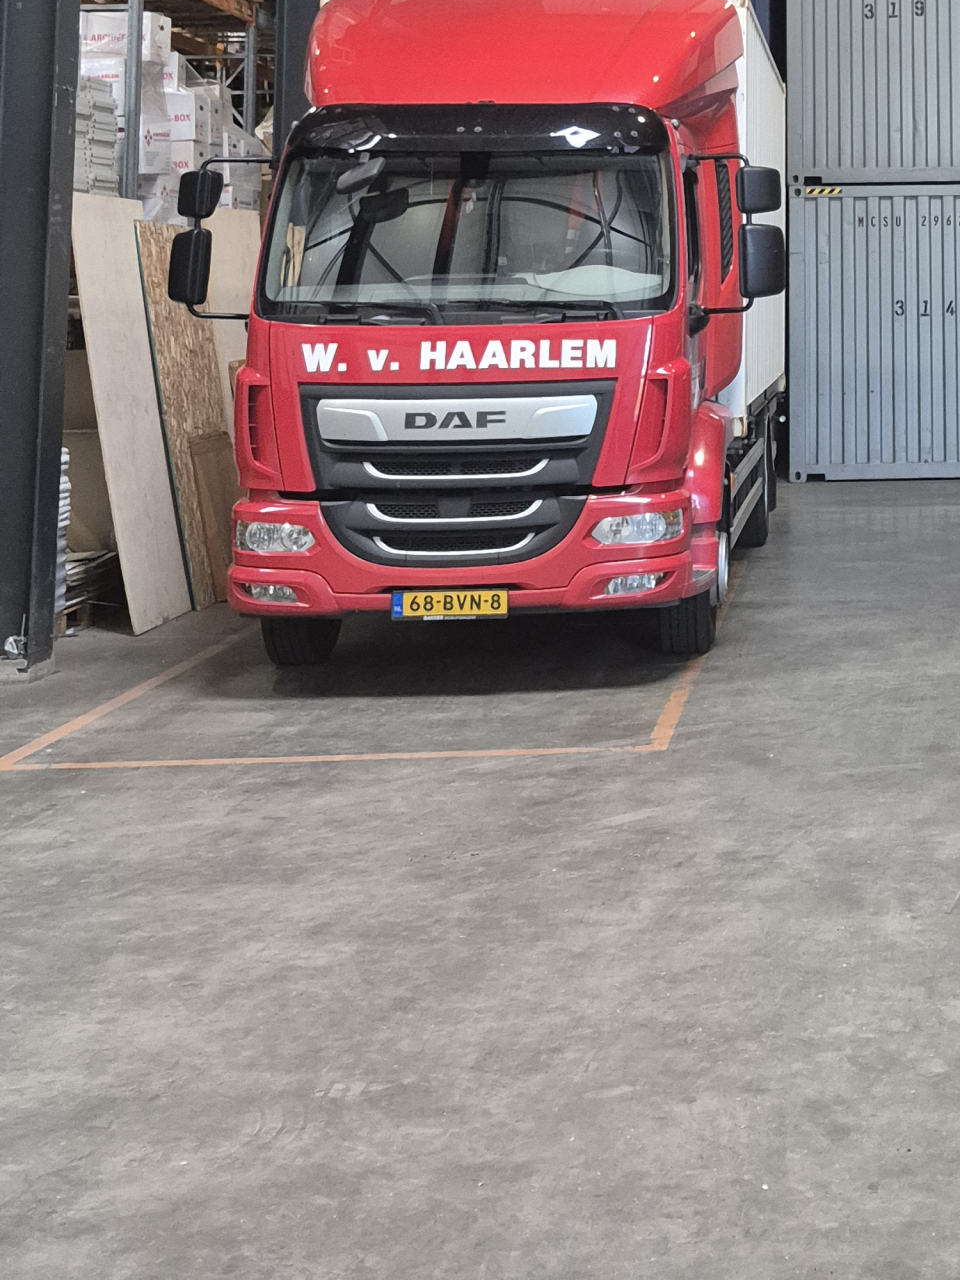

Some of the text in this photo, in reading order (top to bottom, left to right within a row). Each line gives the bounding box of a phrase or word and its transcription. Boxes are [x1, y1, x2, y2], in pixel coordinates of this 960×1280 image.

[857, 215, 902, 228] MCSU
[301, 339, 617, 373] W. v. HAARLEM
[404, 410, 507, 430] DAF
[409, 593, 501, 612] 68-BVN-8
